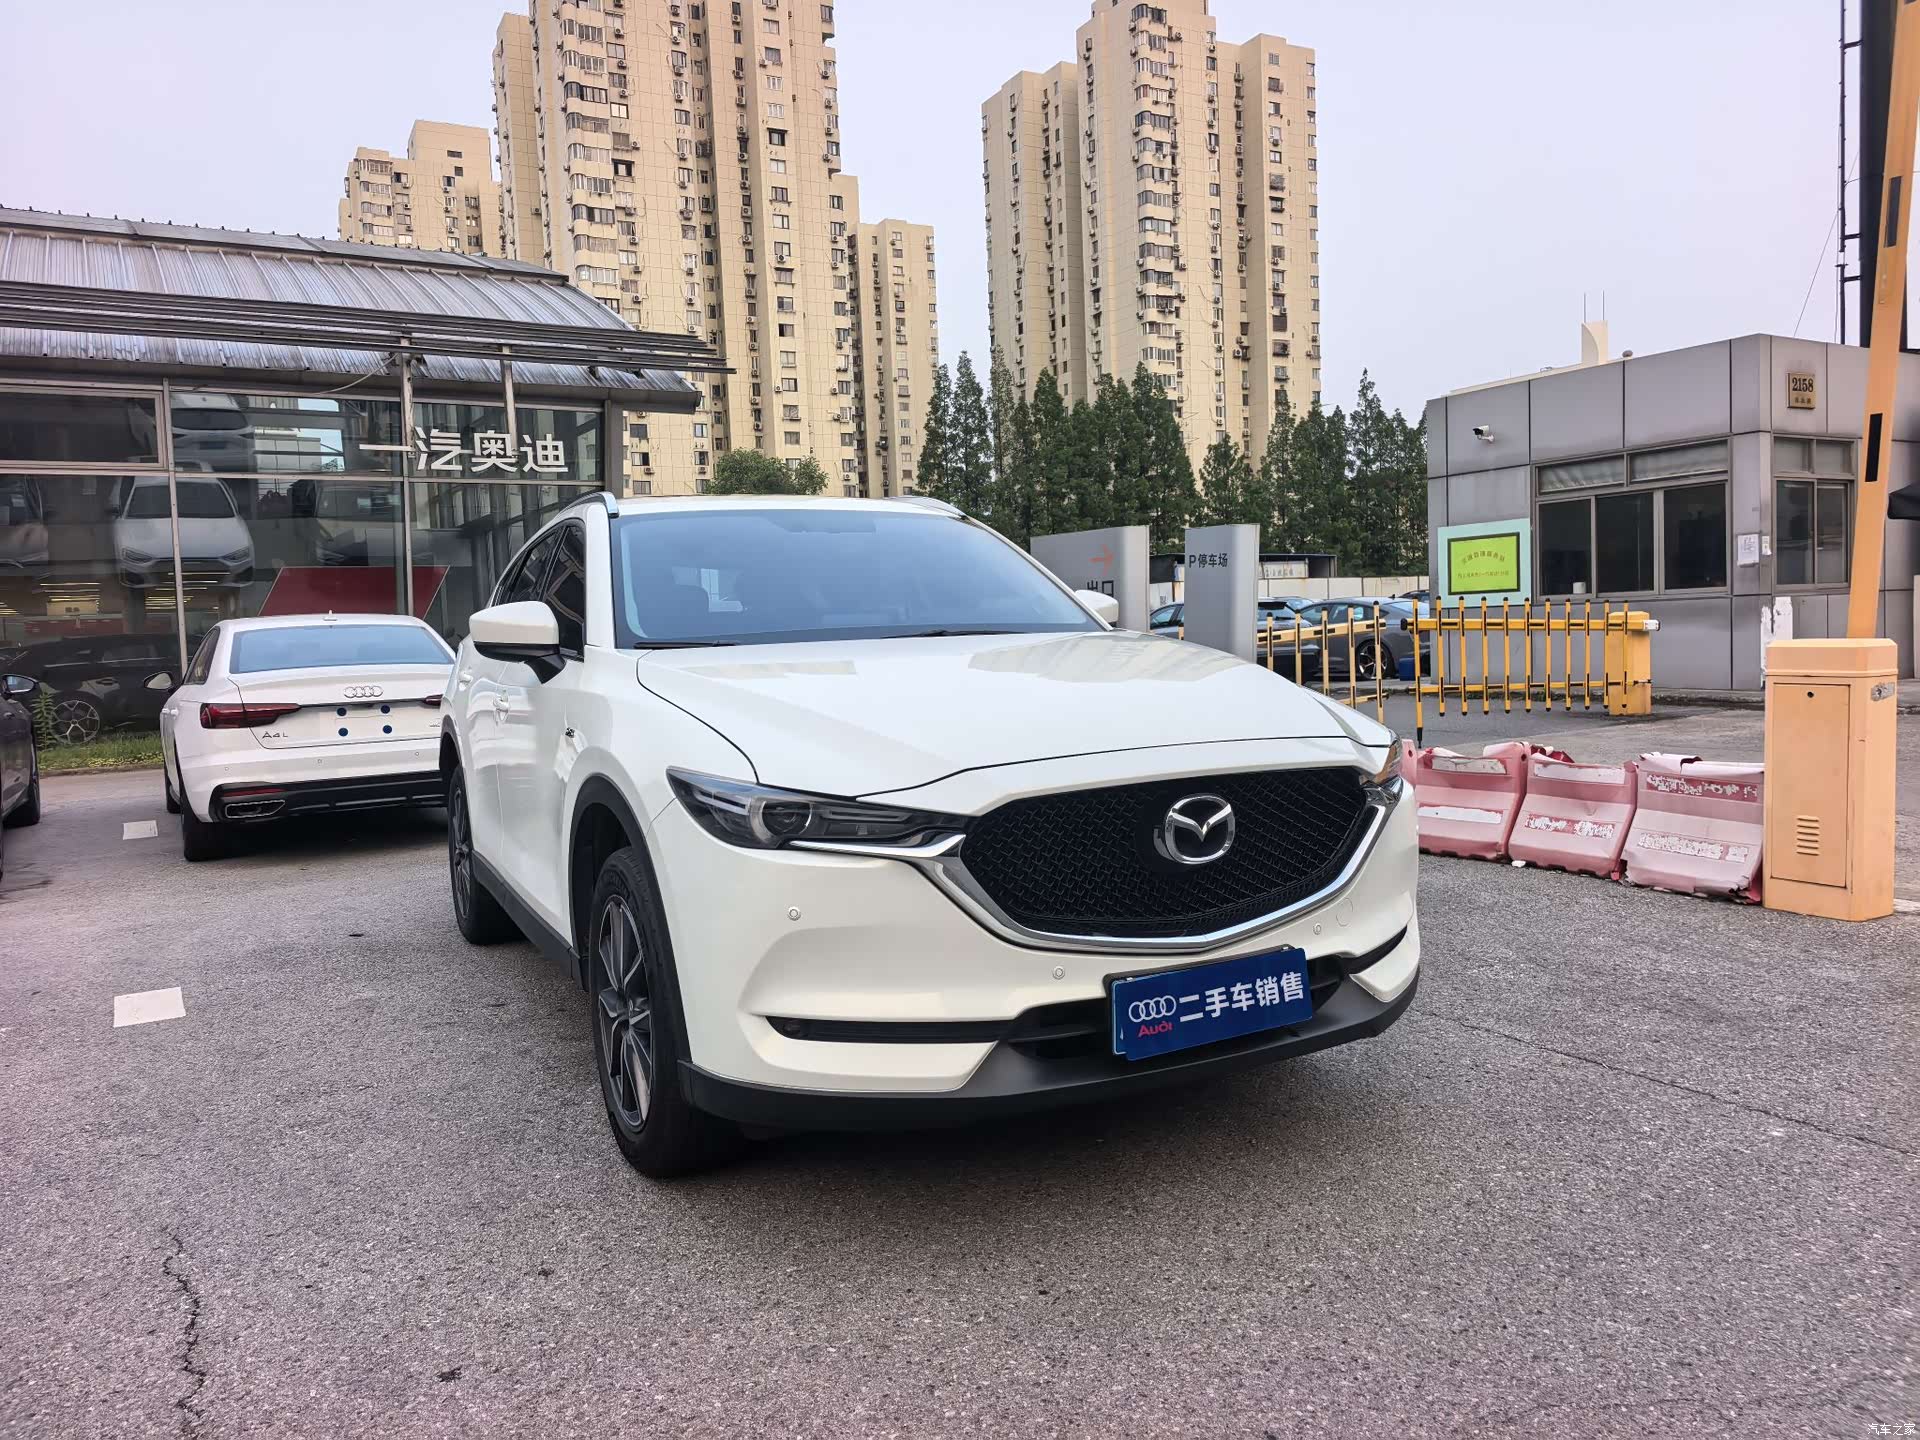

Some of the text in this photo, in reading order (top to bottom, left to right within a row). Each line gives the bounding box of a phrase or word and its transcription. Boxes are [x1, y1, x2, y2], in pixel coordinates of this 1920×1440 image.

[1792, 377, 1814, 392] 2158
[359, 426, 569, 473] 一汽奥迪
[1178, 972, 1304, 1023] 二手车销售
[1137, 1020, 1173, 1038] Audi
